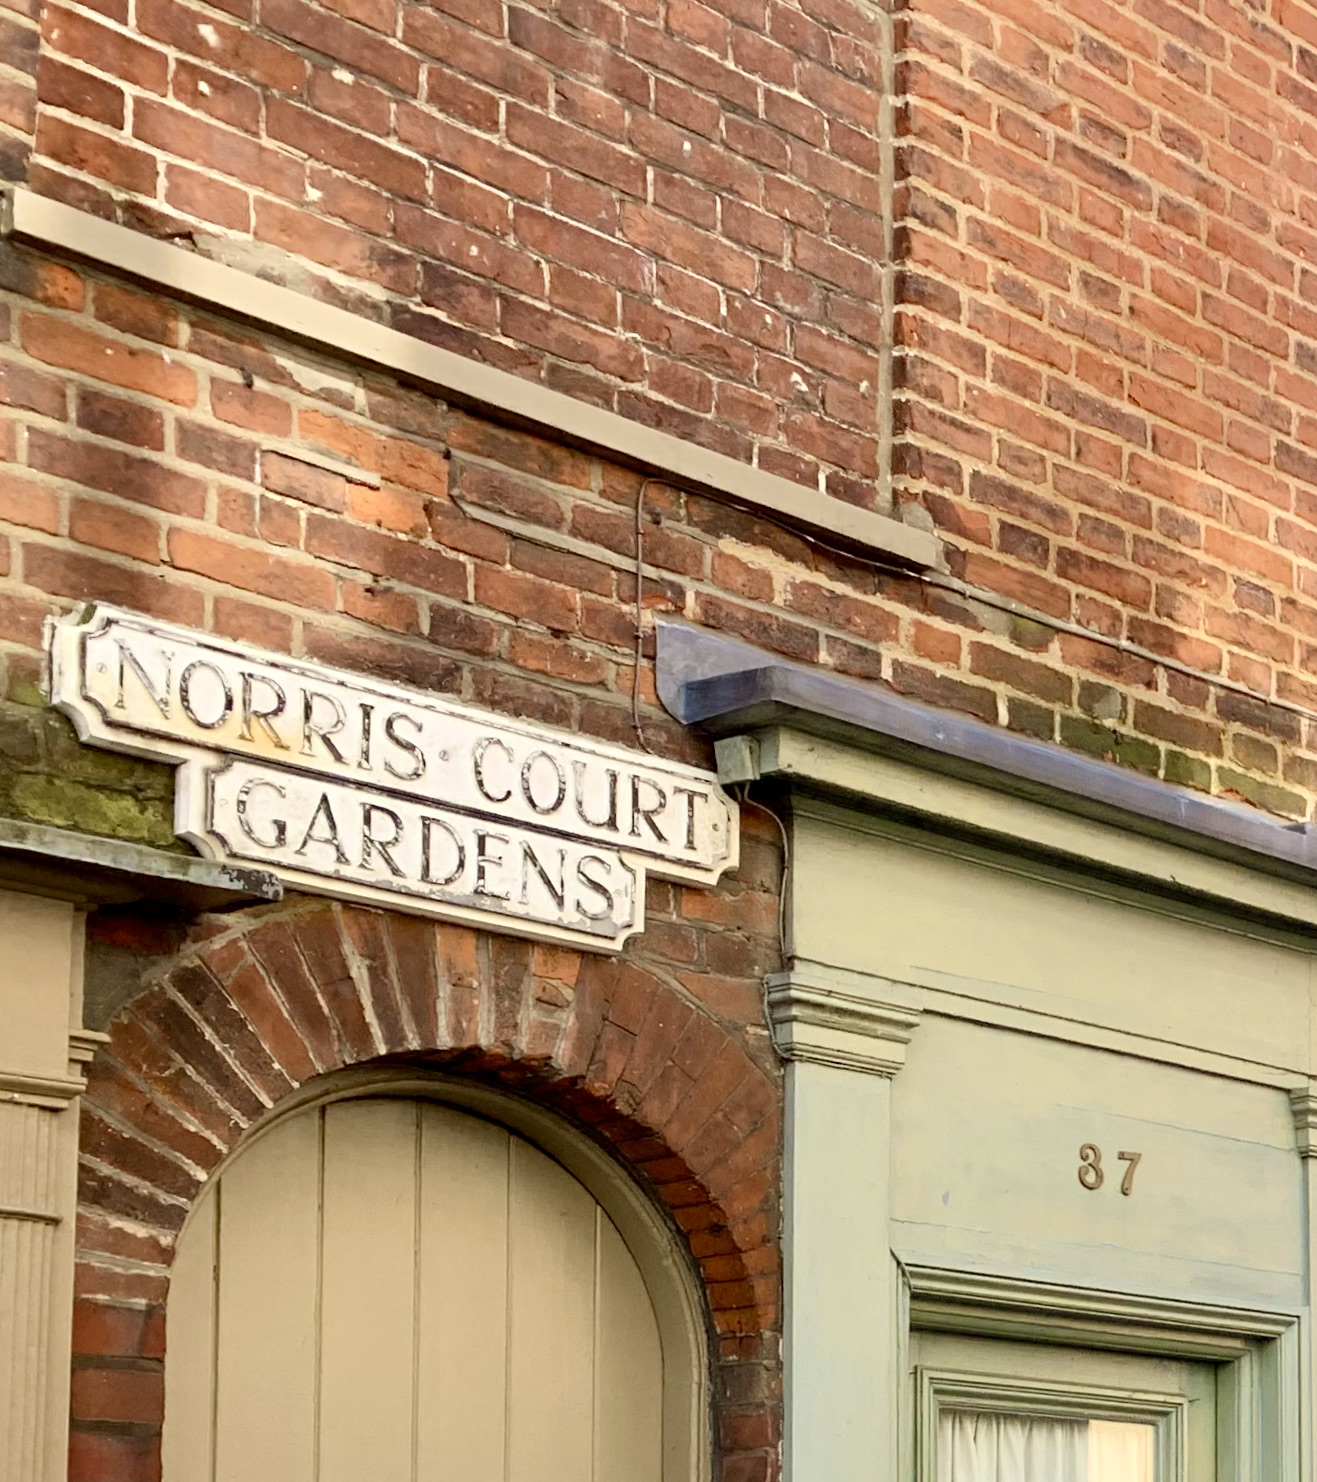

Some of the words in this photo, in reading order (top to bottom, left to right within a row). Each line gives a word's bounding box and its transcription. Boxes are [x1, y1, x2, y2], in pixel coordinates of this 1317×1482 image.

[113, 636, 428, 782] NORRIS
[471, 735, 709, 852] COURT
[236, 777, 615, 921] GARDENS
[1077, 1142, 1143, 1197] 37
